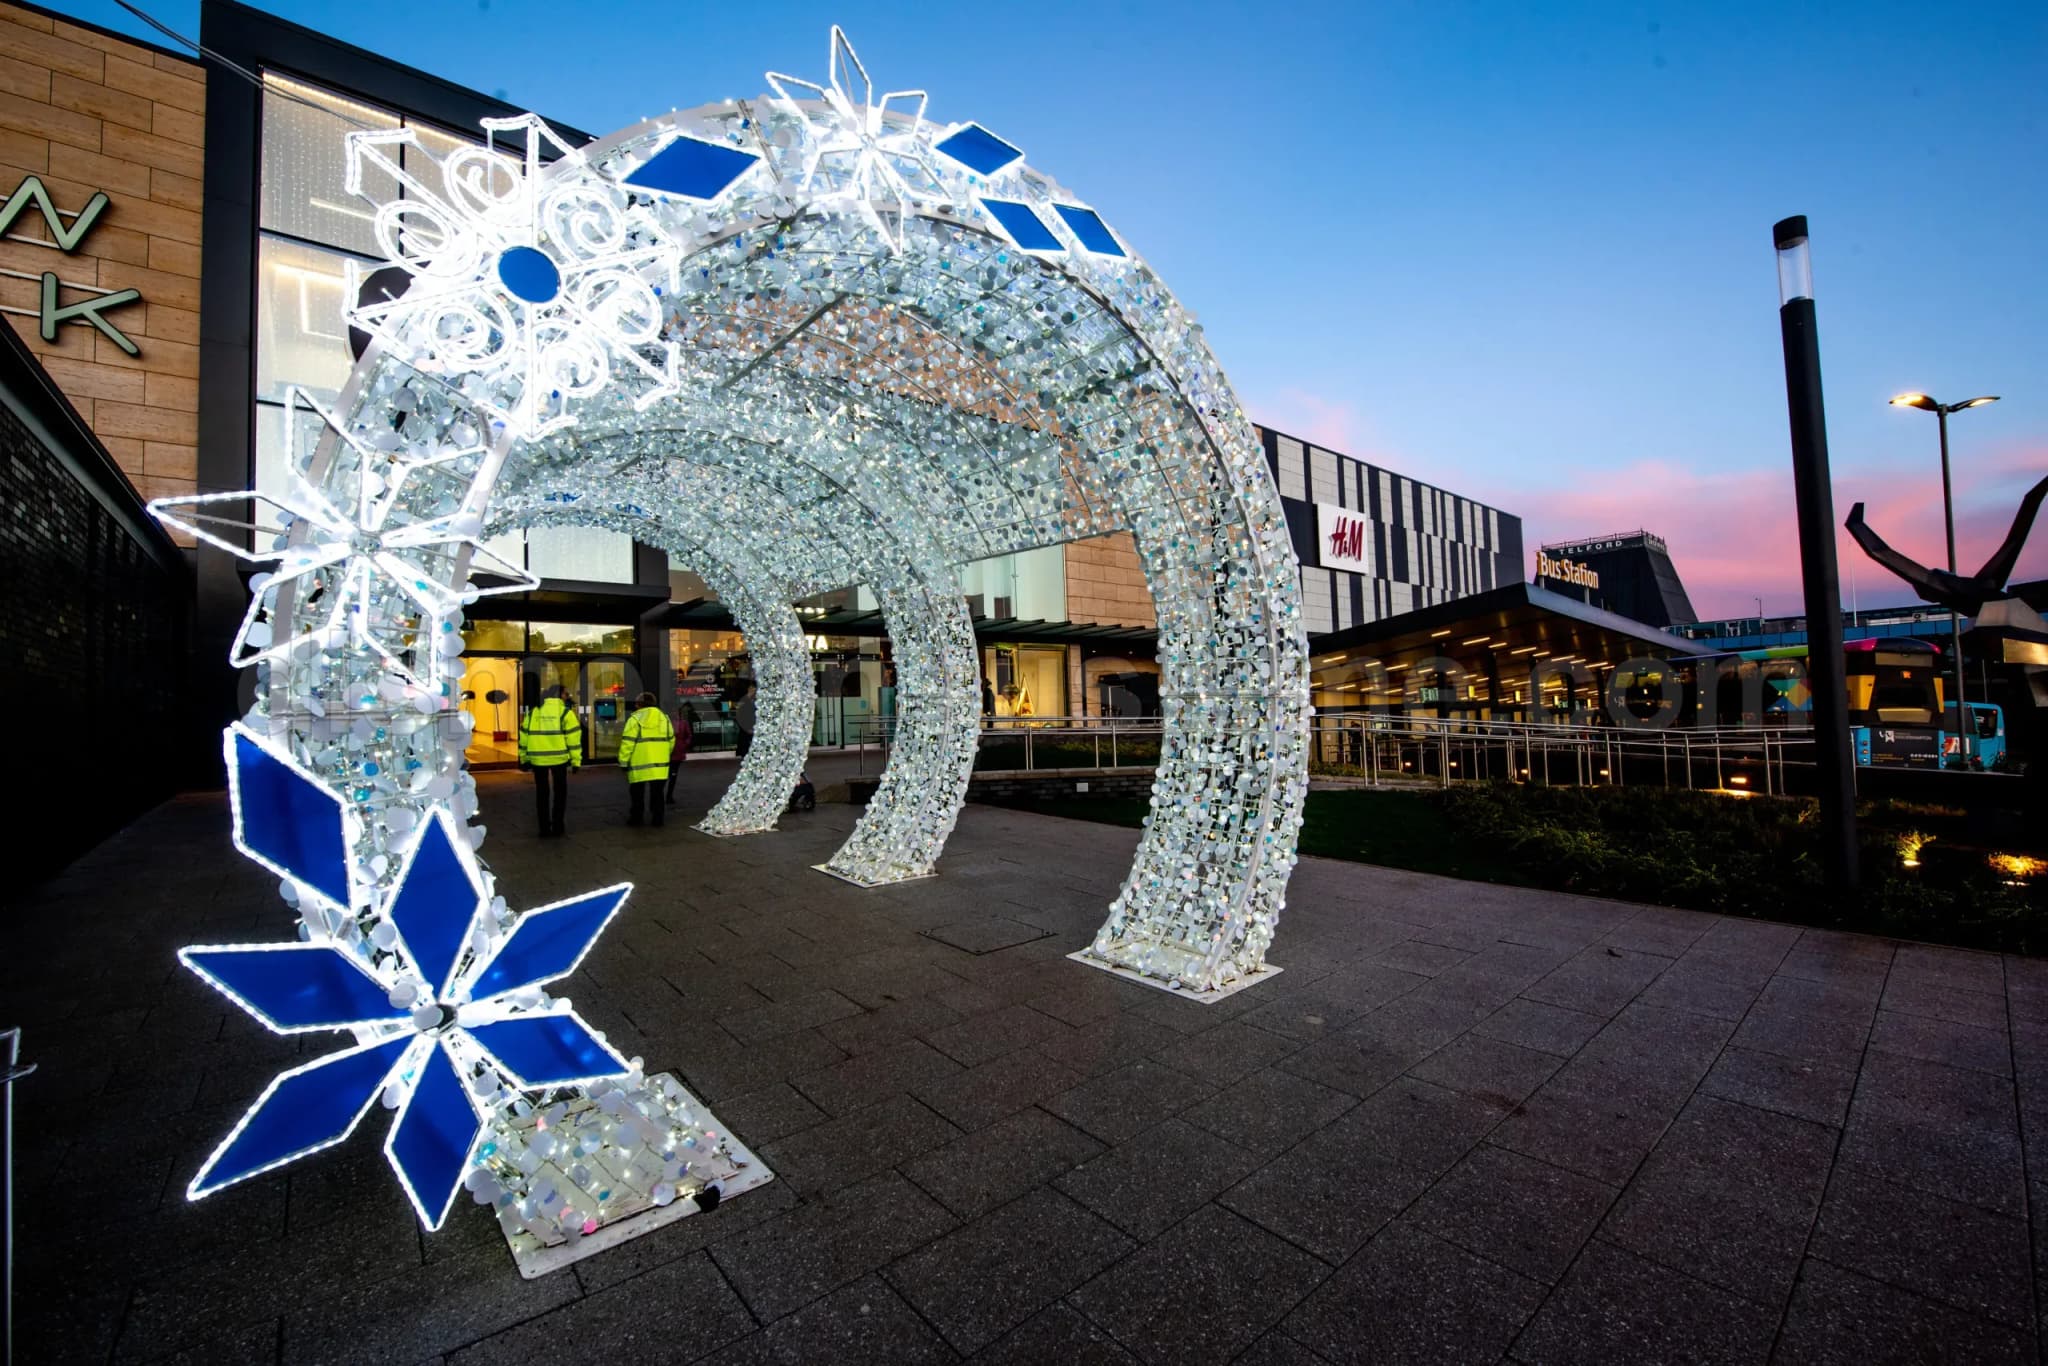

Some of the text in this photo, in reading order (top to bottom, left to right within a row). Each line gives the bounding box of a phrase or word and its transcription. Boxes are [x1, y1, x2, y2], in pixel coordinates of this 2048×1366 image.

[1330, 515, 1364, 562] H&M
[1559, 539, 1624, 556] TELFORD
[1538, 551, 1600, 590] Bus Station
